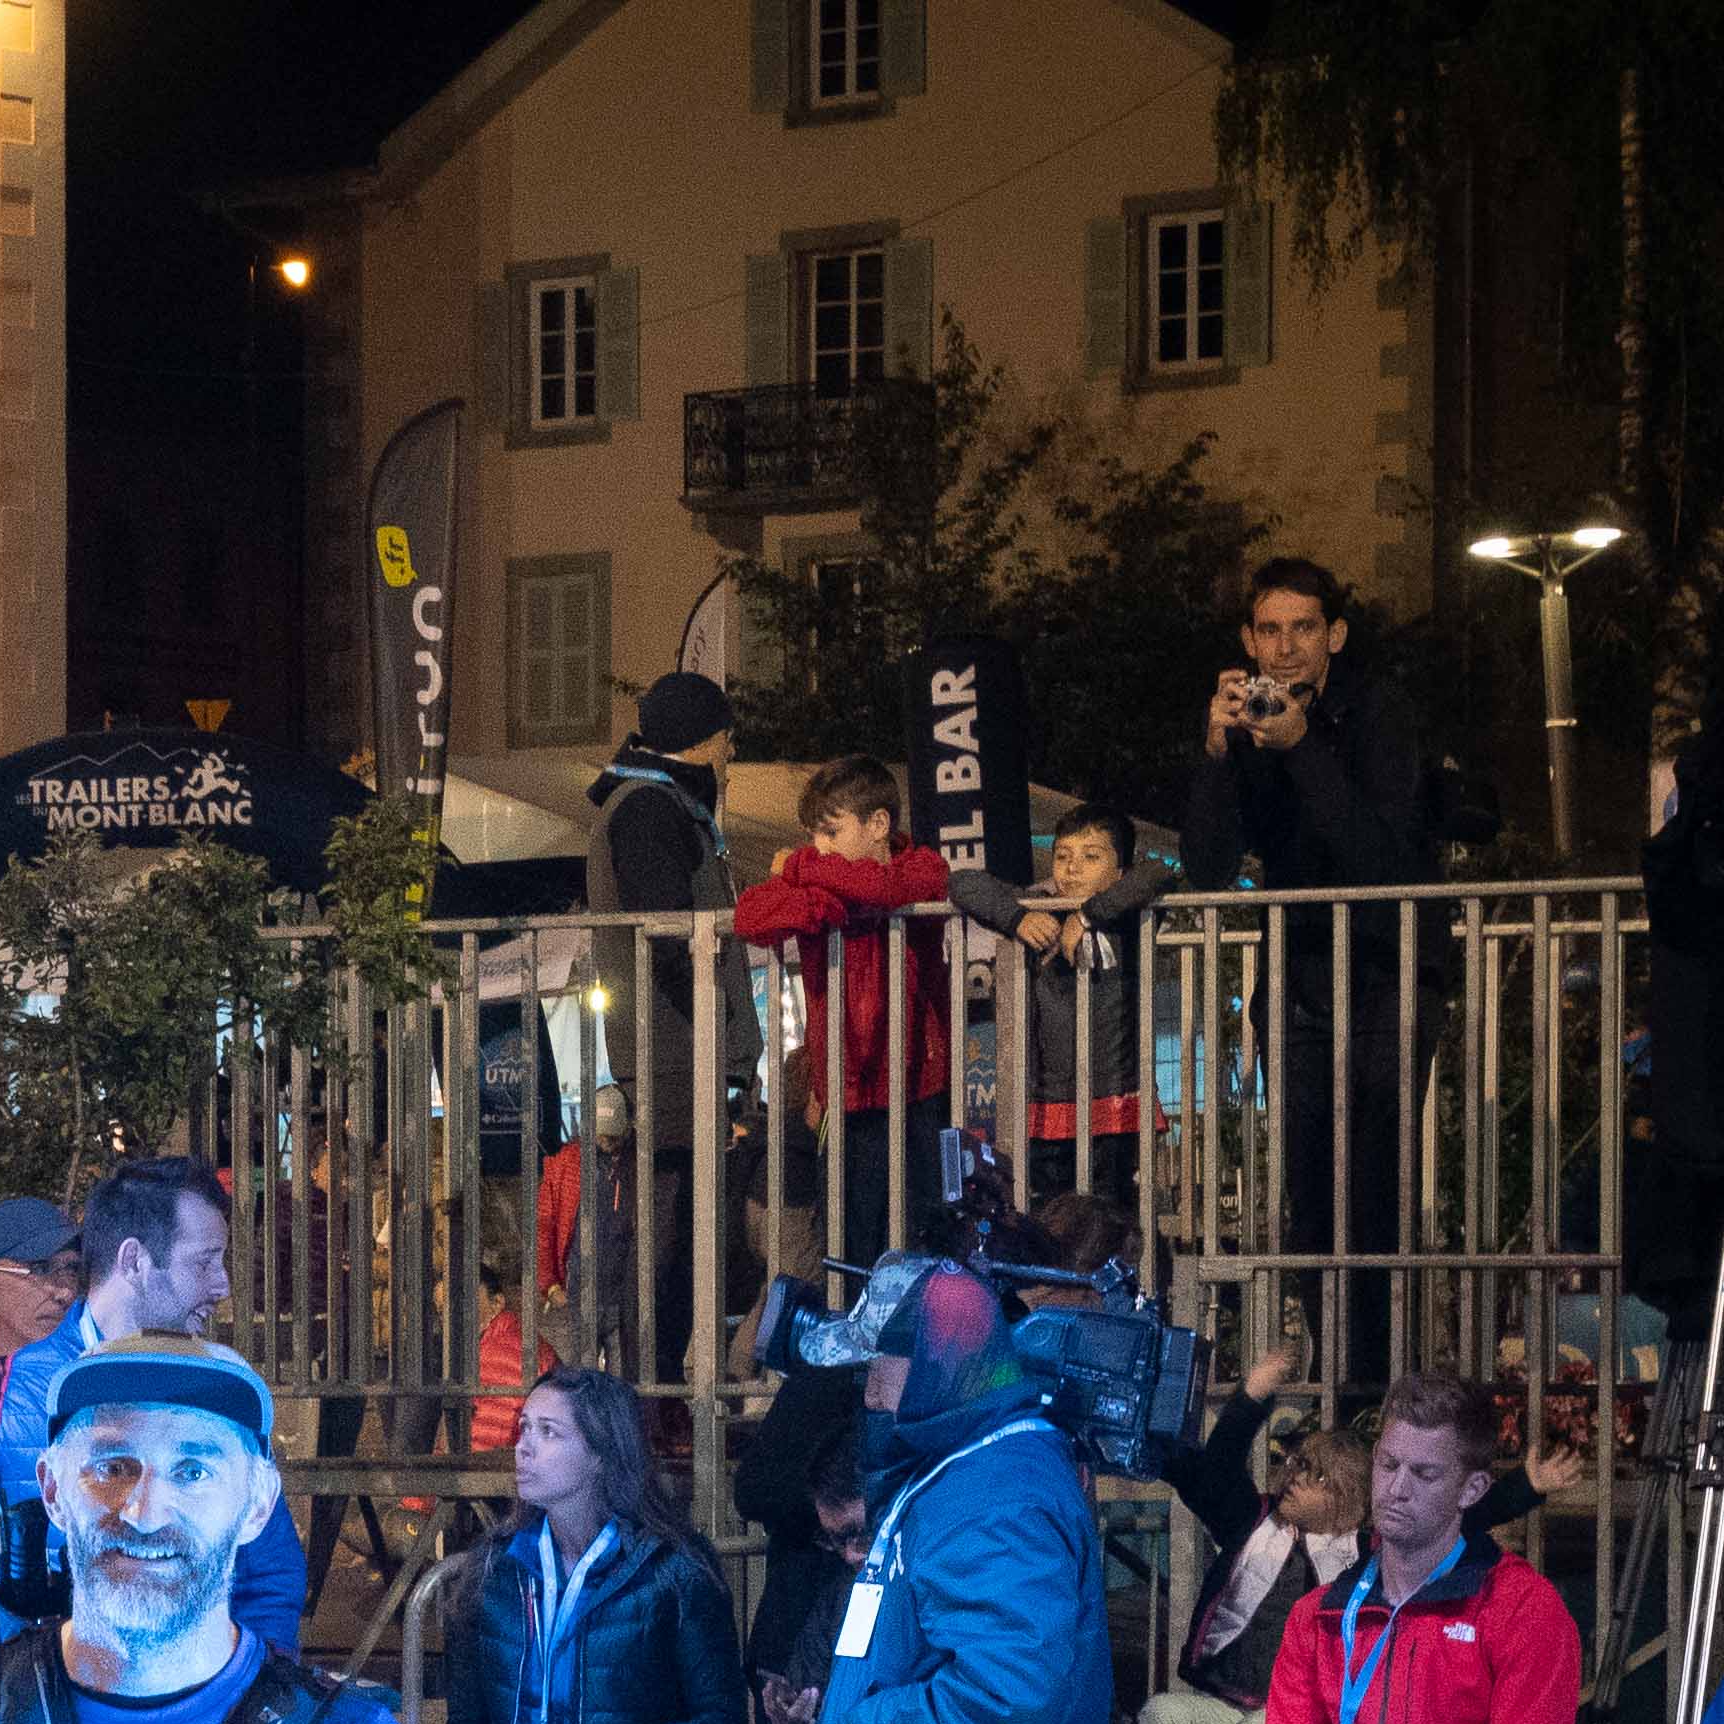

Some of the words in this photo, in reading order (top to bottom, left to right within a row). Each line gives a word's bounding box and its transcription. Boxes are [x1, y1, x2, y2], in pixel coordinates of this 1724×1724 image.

[931, 663, 981, 794] BAR
[28, 776, 171, 804] TRAILERS
[46, 800, 253, 831] MONT-BLANC
